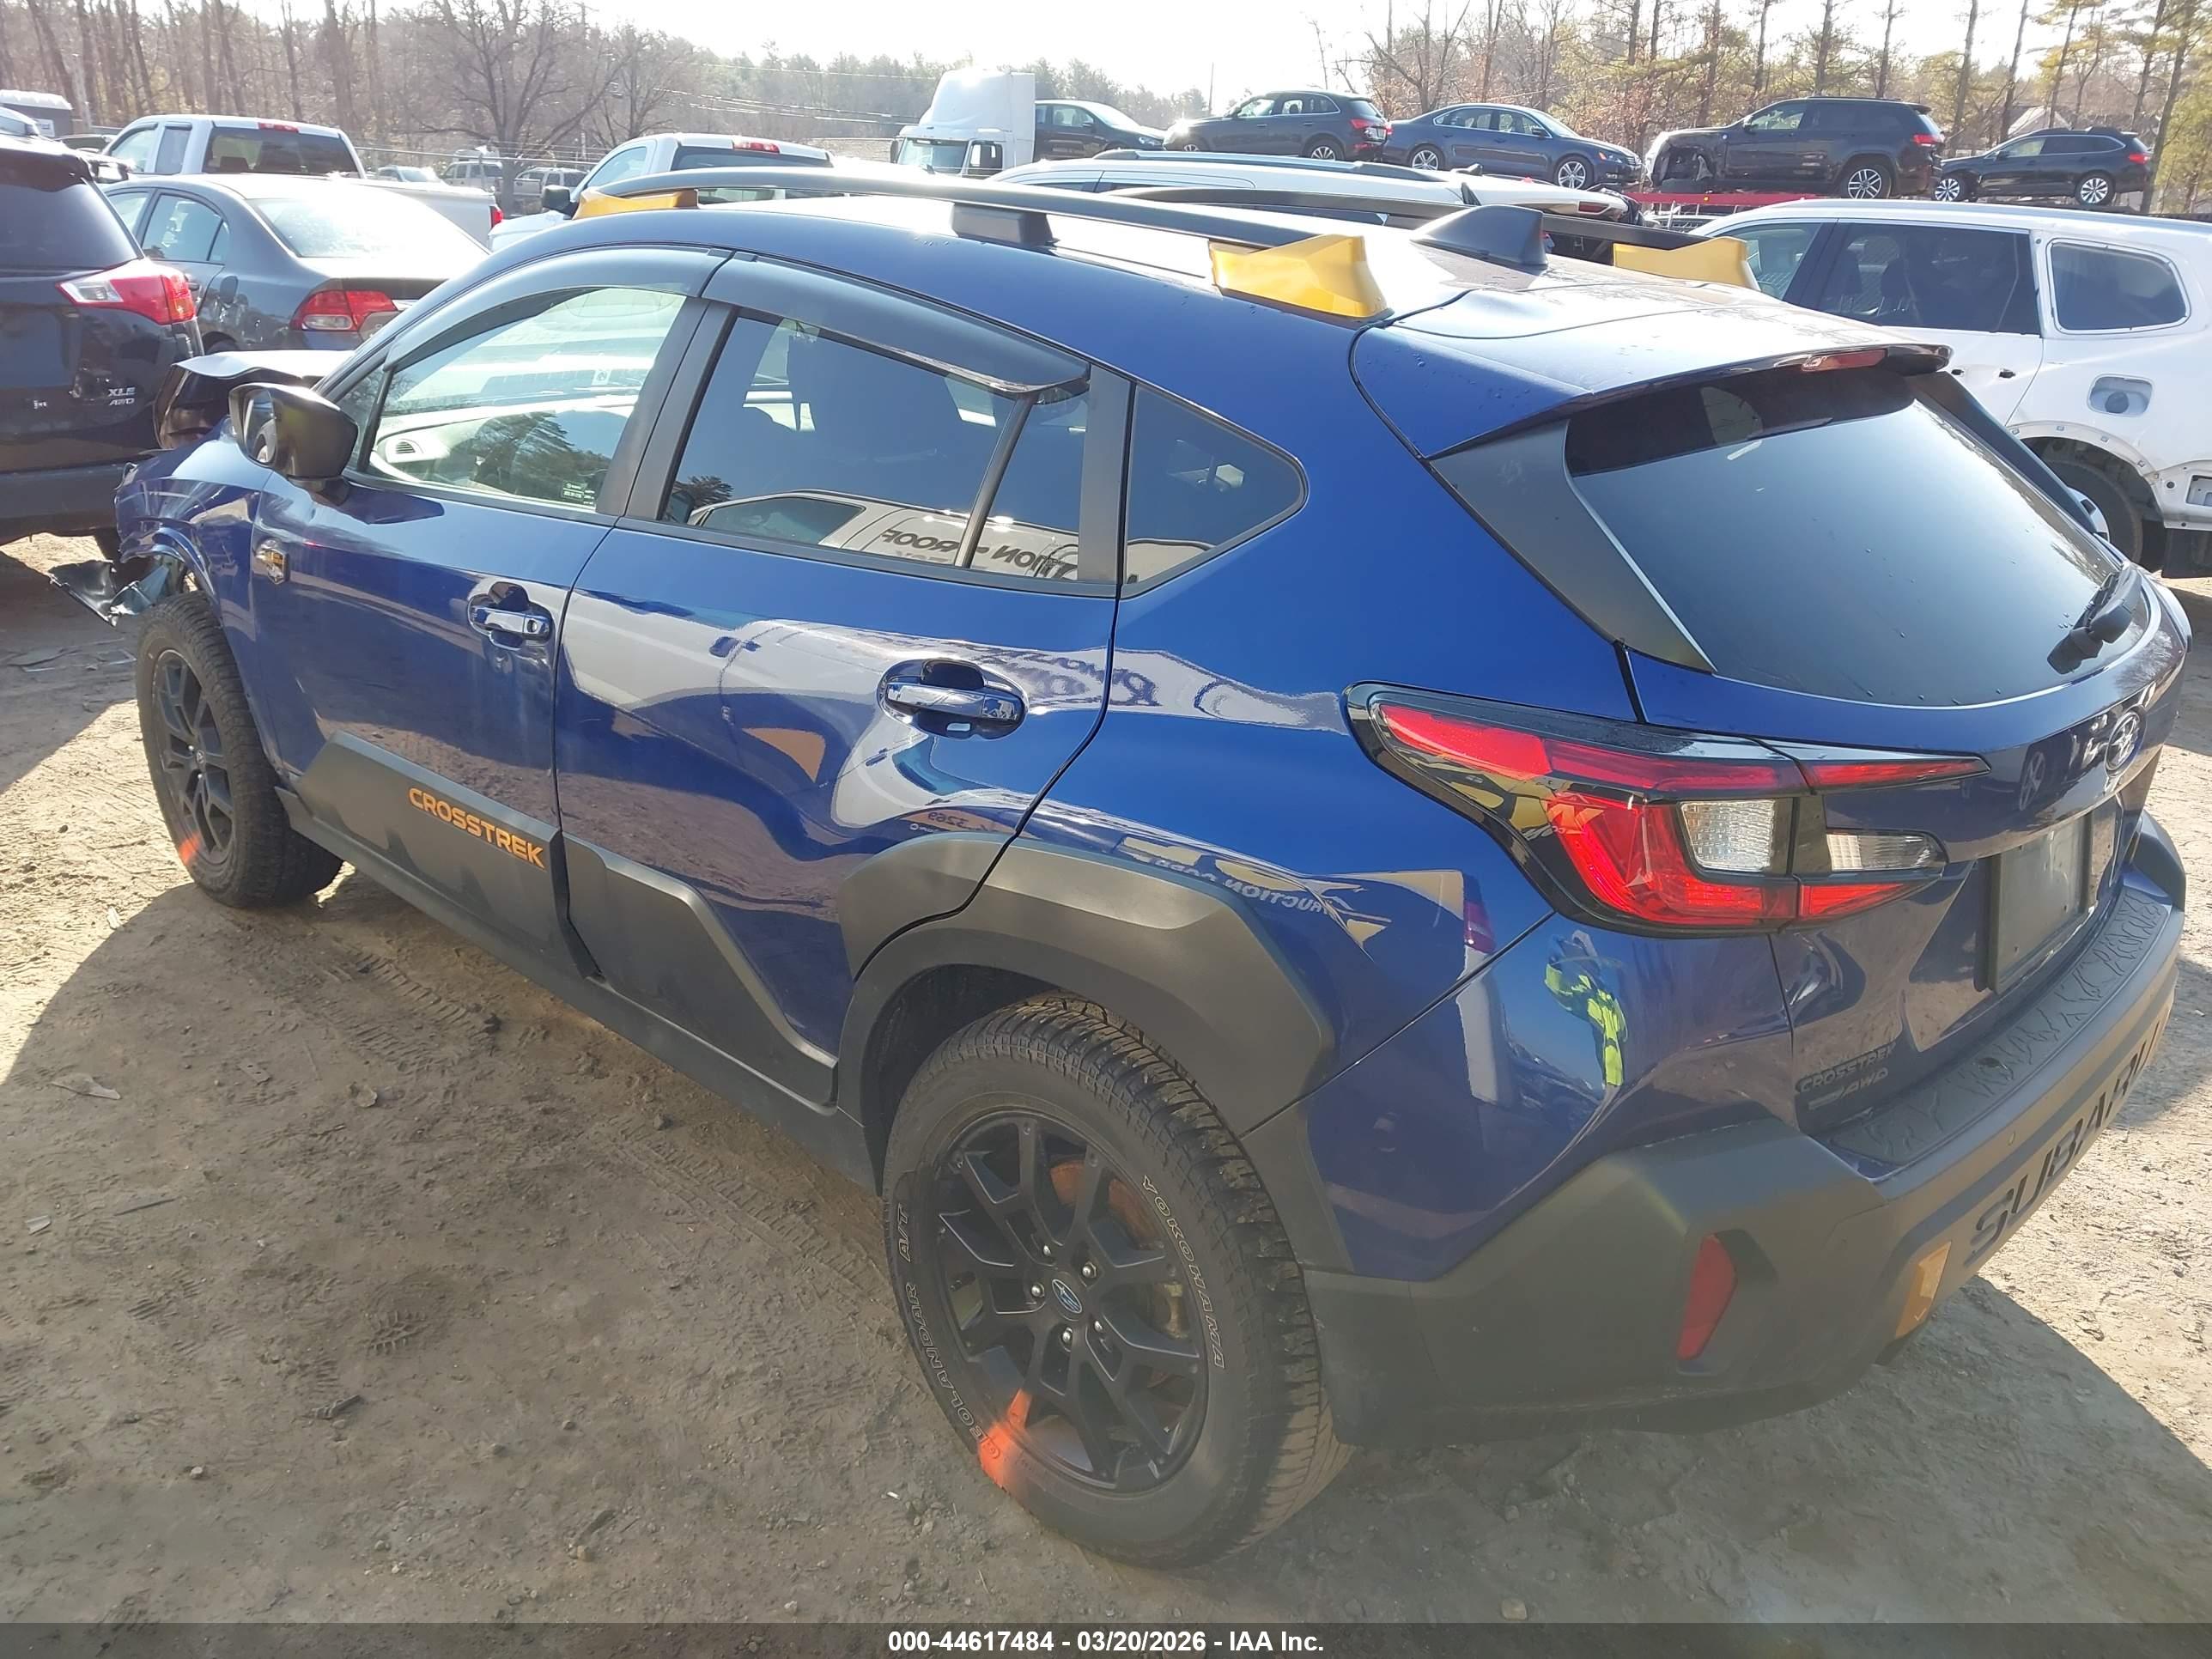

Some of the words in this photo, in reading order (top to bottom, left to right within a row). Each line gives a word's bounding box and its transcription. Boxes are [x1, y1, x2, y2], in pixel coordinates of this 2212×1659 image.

[108, 386, 136, 397] XLE
[409, 787, 544, 869] CROSSTREK
[1800, 1042, 1896, 1092] CROSSTREK
[1840, 1067, 1889, 1099] AWD
[897, 1202, 911, 1262] A/T
[1142, 1174, 1224, 1369] YOKOHAMA
[905, 1282, 1000, 1459] GEOLANDAR
